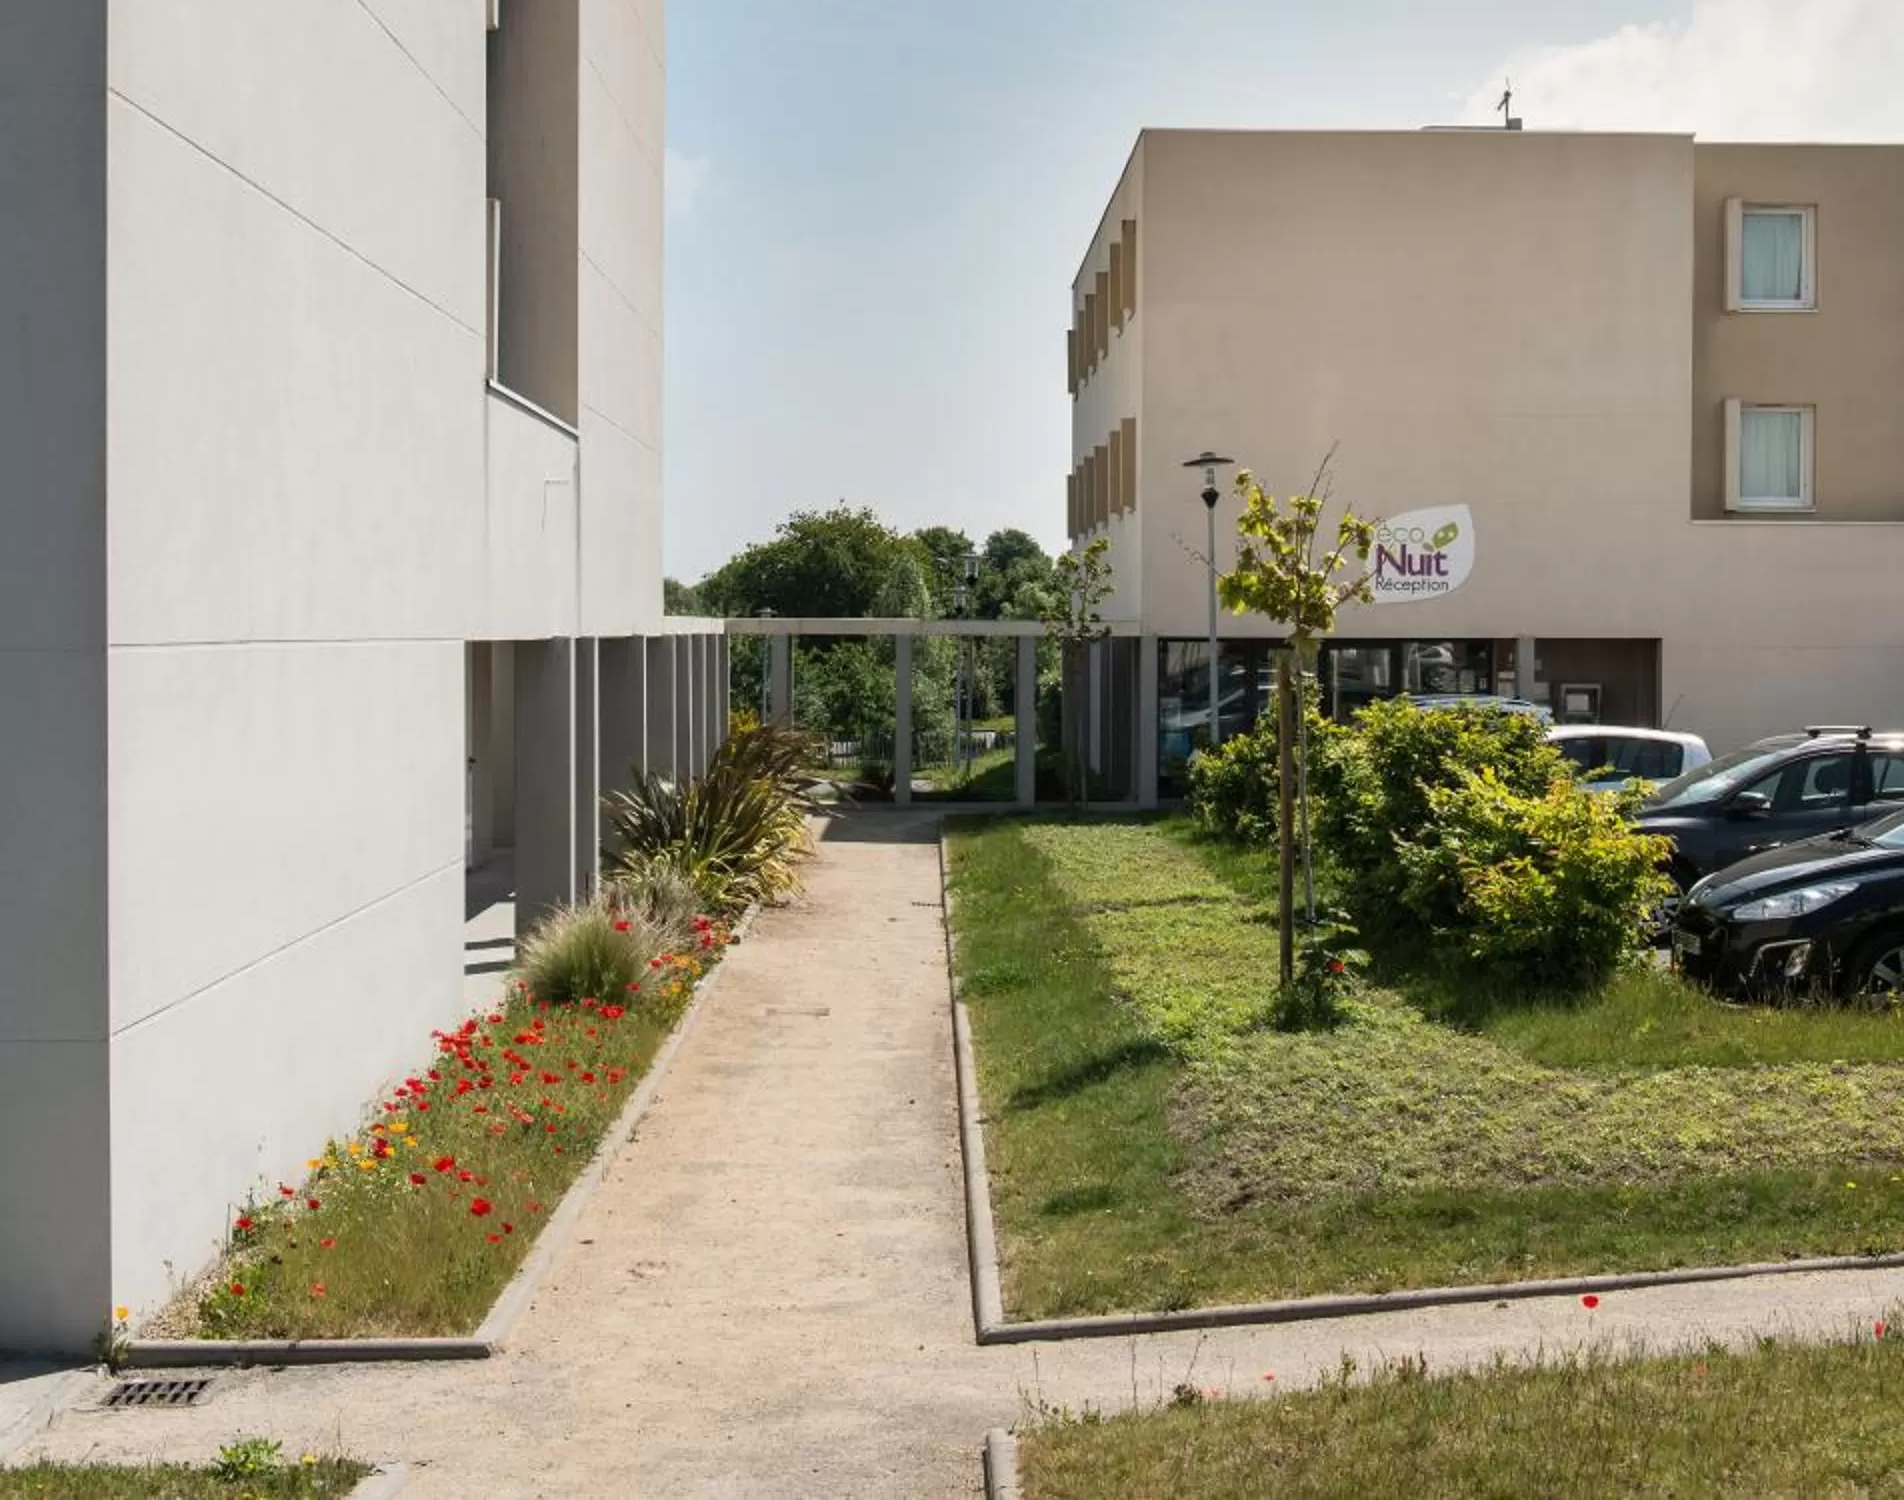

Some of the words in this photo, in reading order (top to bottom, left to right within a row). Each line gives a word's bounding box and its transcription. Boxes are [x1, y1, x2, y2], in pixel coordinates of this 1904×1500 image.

[1377, 526, 1425, 543] eco
[1375, 543, 1449, 577] Nuit
[1375, 577, 1449, 594] Réception
